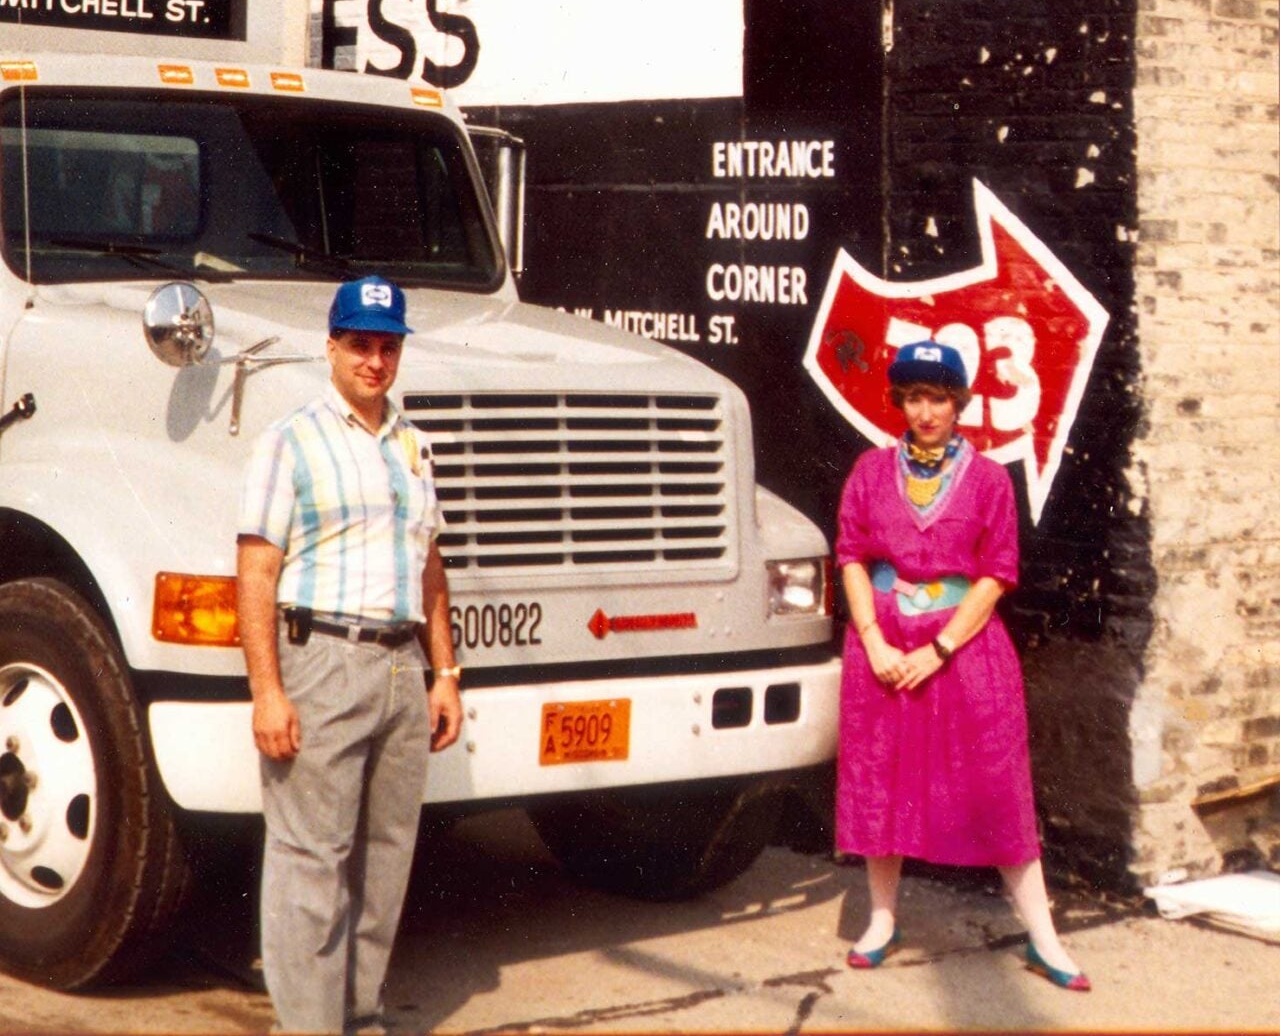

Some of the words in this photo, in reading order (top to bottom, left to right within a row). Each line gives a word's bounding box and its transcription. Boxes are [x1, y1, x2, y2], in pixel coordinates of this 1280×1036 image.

[711, 139, 836, 178] ENTRANCE
[705, 202, 811, 241] AROUND
[705, 262, 809, 306] CORNER
[603, 309, 701, 343] MITCHELL
[708, 315, 740, 345] ST.
[449, 602, 543, 650] 600822
[560, 711, 613, 749] 5909
